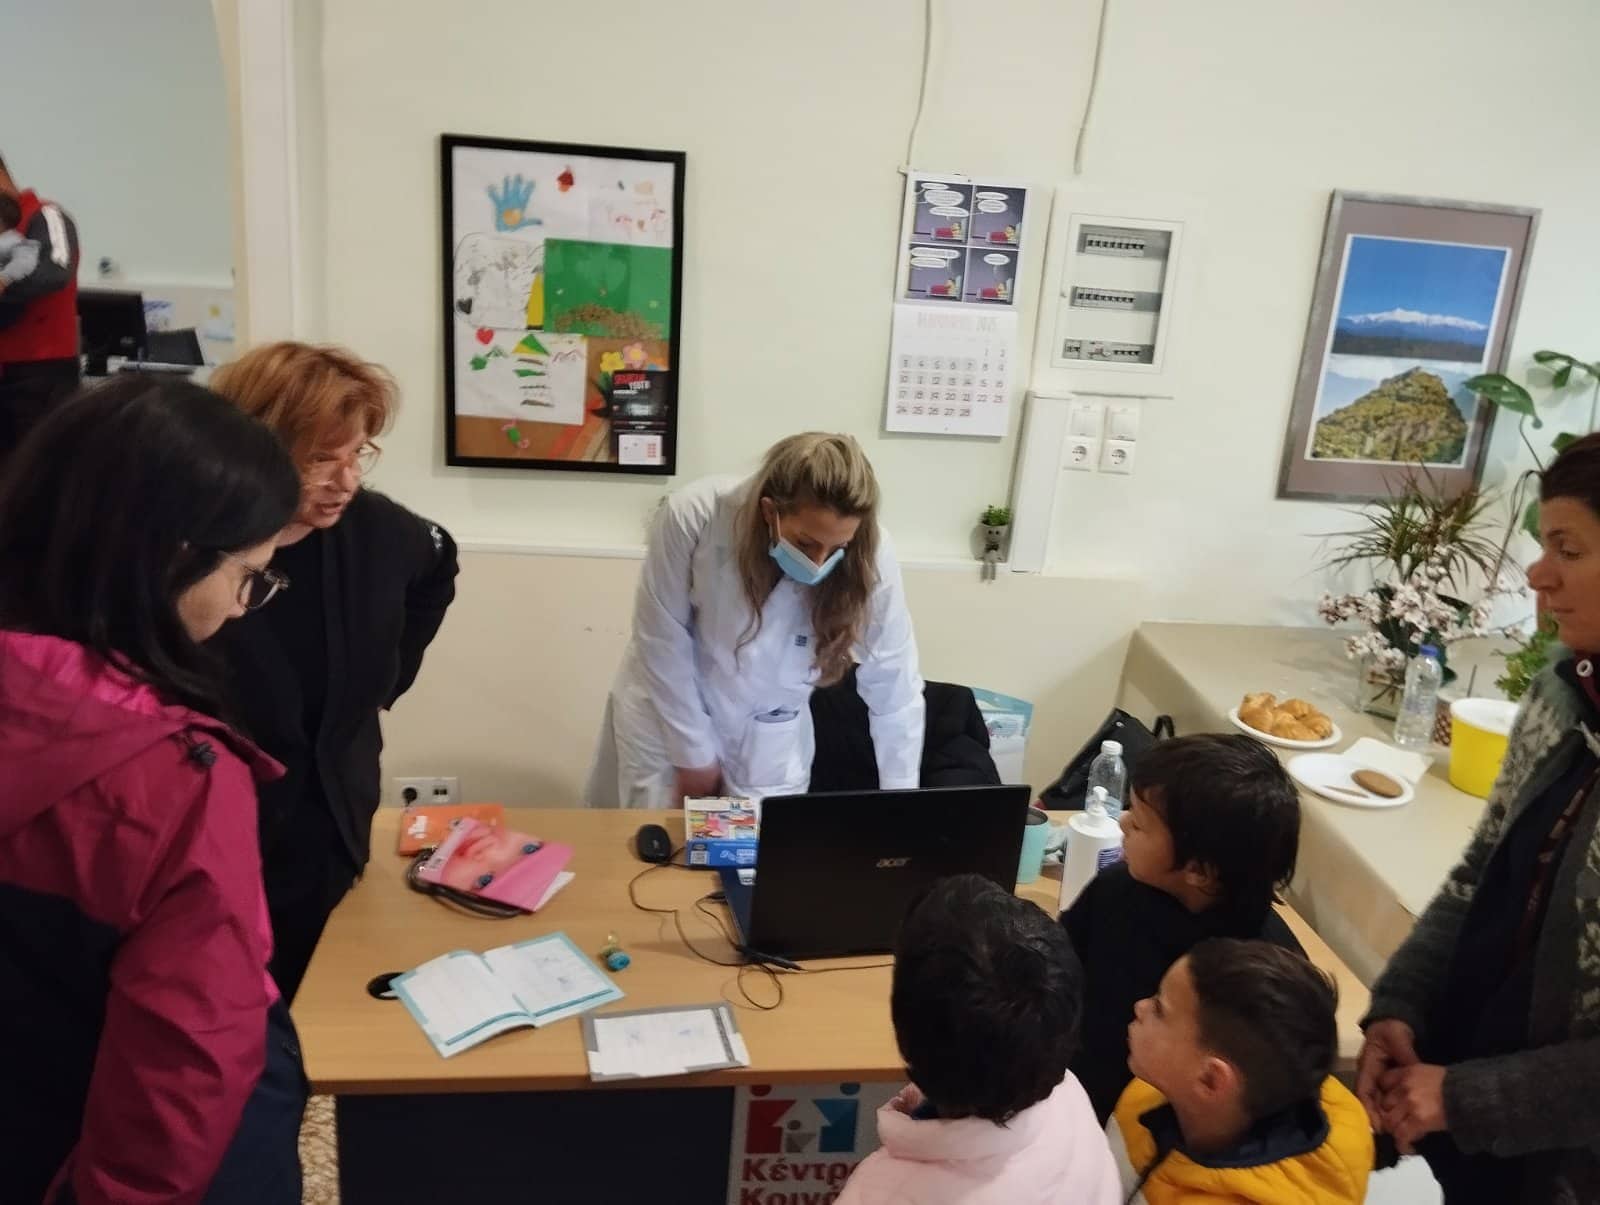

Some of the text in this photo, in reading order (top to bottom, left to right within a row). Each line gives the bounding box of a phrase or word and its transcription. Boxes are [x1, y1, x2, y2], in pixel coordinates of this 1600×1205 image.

[945, 392, 956, 402] 20
[976, 393, 988, 403] 22
[741, 1157, 860, 1185] Κέντρ
